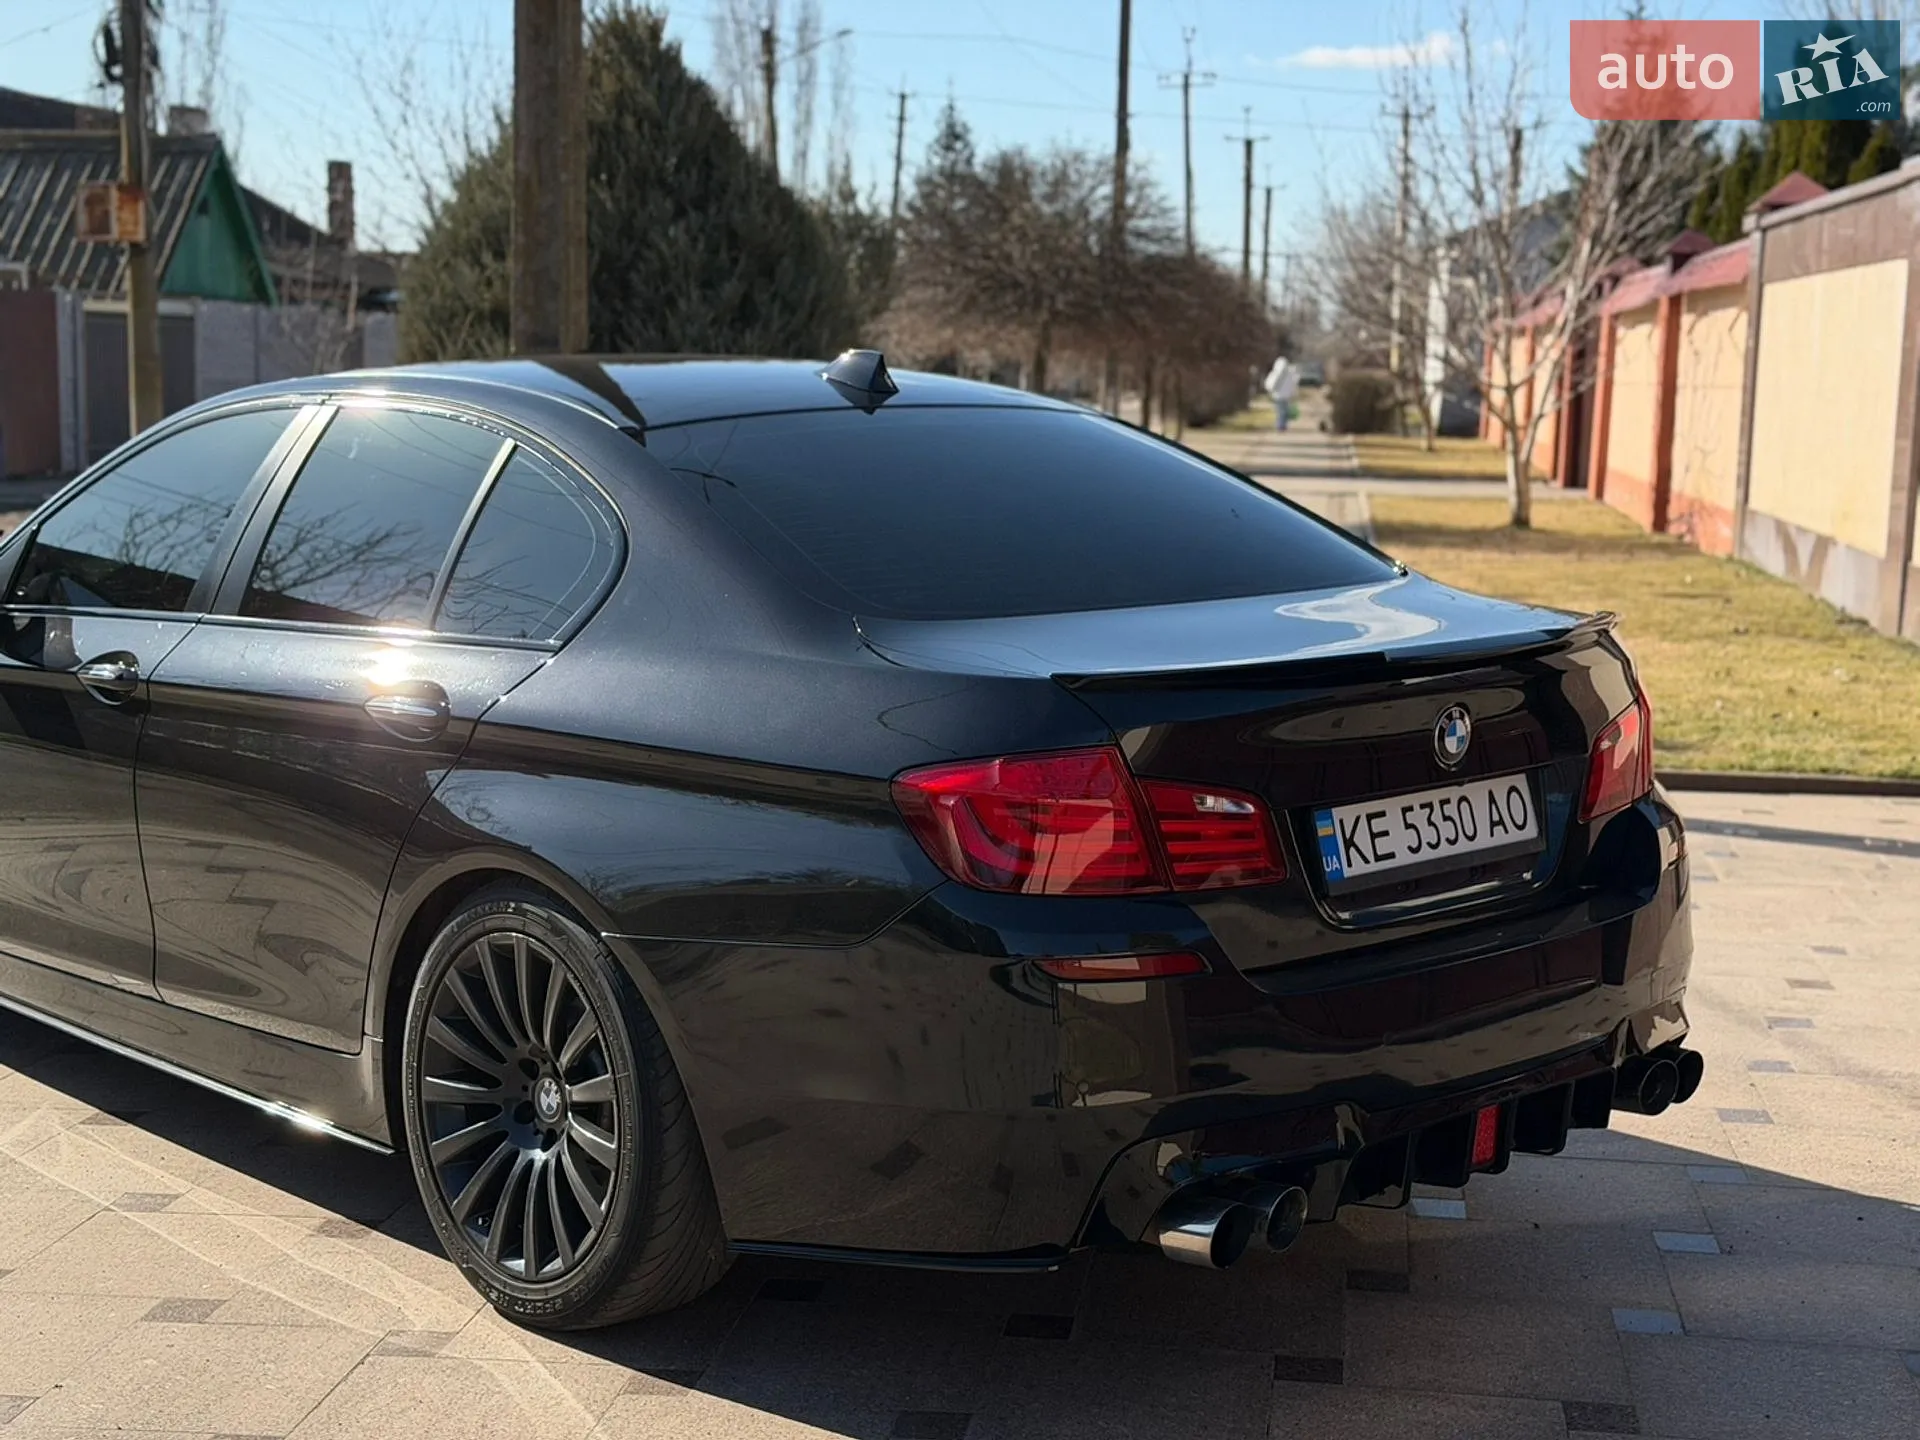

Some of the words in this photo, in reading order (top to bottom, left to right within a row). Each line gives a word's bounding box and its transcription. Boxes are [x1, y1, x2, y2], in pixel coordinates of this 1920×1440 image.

[1339, 811, 1396, 868] KE
[1401, 796, 1477, 854] 5350
[1488, 785, 1528, 838] AO
[1322, 855, 1341, 872] UA
